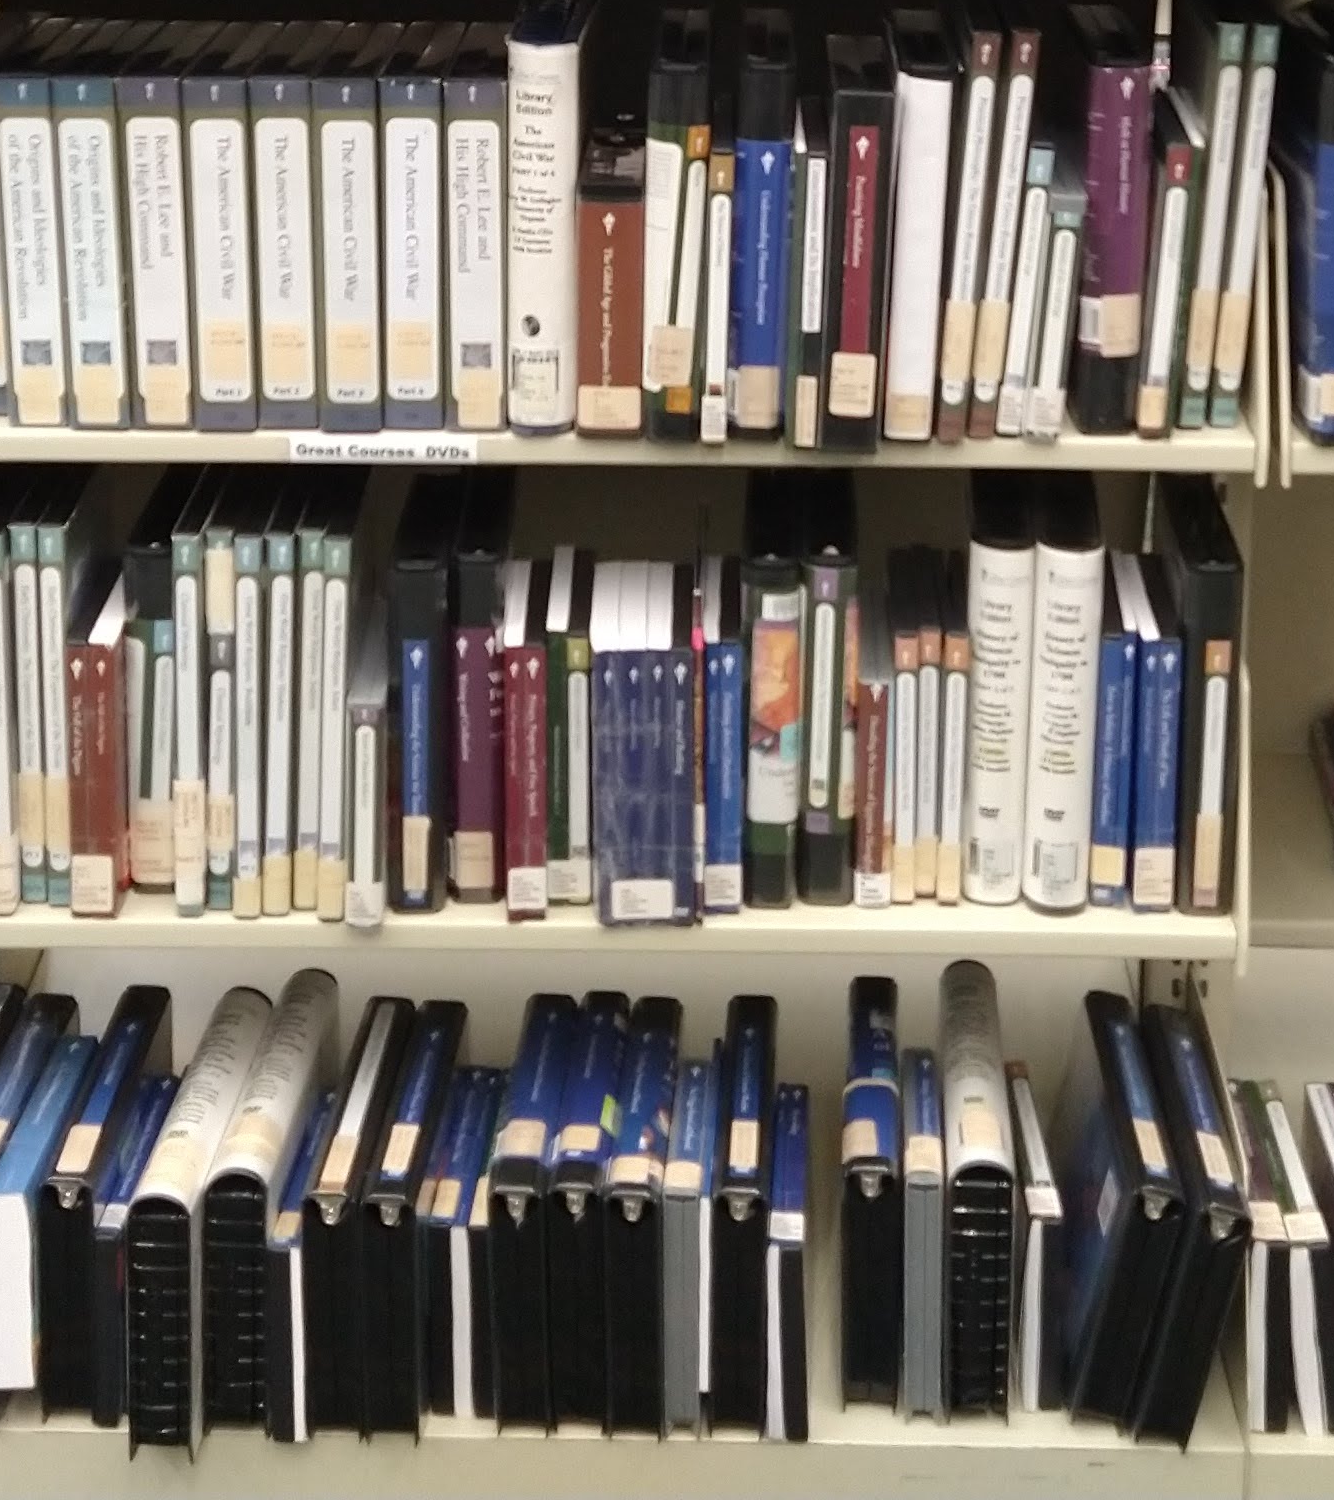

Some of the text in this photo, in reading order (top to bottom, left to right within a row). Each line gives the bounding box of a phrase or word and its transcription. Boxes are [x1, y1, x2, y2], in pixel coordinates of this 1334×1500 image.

[405, 136, 420, 301] The American Civil War
[296, 443, 470, 459] Great Courses DVDs
